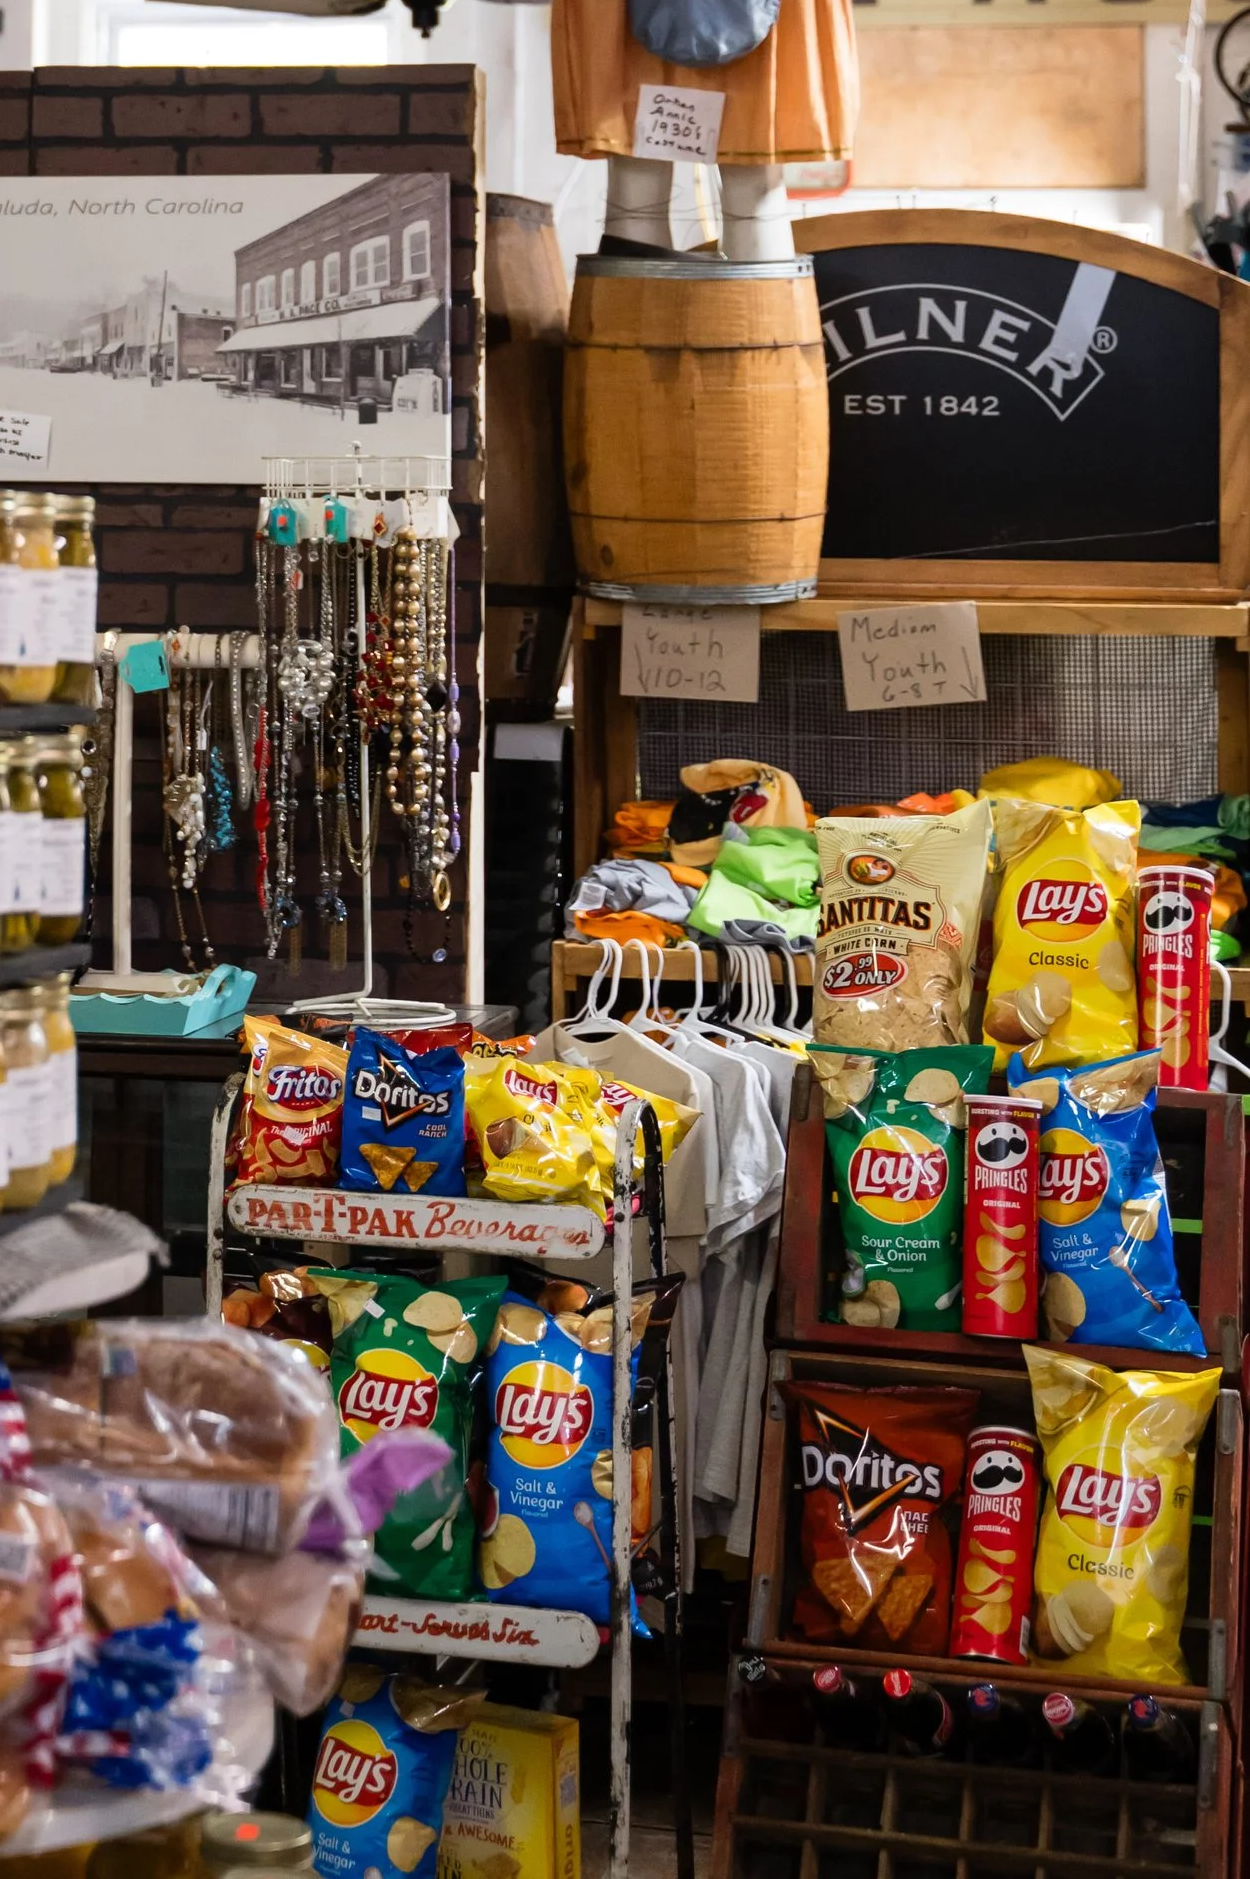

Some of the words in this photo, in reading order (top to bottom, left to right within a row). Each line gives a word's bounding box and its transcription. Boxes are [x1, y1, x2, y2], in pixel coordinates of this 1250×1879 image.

[67, 198, 136, 215] North
[144, 197, 244, 215] Carolina
[822, 296, 1085, 399] ILNER
[843, 394, 907, 415] EST
[923, 394, 1000, 416] 1842
[646, 627, 724, 659] Youth
[655, 667, 726, 692] 10-12
[861, 650, 947, 682] Youth
[1021, 880, 1105, 924] Lay's
[816, 895, 932, 938] SANTITAS
[833, 939, 861, 955] WHITE
[864, 938, 897, 950] CORN
[1142, 934, 1193, 959] PRINGLES
[1028, 951, 1089, 970] Classic
[854, 971, 898, 986] ONLY
[267, 1064, 343, 1102] Fritos
[354, 1069, 450, 1115] Doritos
[289, 1120, 333, 1138] RIGINAL
[425, 1123, 447, 1132] COOL
[855, 1149, 946, 1202] Lay's
[974, 1164, 1028, 1195] PRINGLES
[983, 1199, 1021, 1209] ORIGINAL
[861, 1234, 893, 1248] Sour
[895, 1236, 940, 1249] Cream
[1050, 1246, 1099, 1263] Vinegar
[1052, 1235, 1079, 1249] Salt
[1083, 1233, 1093, 1245] &
[875, 1248, 885, 1262] &
[887, 1249, 927, 1262] Onion
[345, 1372, 435, 1432] Lay's
[500, 1383, 588, 1446] Lay's
[802, 1445, 941, 1498] Doritos
[515, 1478, 542, 1494] Salt
[546, 1480, 556, 1495] &
[1061, 1465, 1157, 1528] Lay's
[509, 1491, 564, 1512] Vinegar
[968, 1494, 1021, 1522] PRINGLES
[973, 1524, 1012, 1536] ORIGINAL
[1067, 1553, 1135, 1581] Classic
[358, 1612, 490, 1642] art-Serves
[492, 1617, 540, 1647] Six
[458, 1736, 493, 1759] 00%
[315, 1738, 392, 1803] Lay's
[454, 1755, 509, 1787] HOLE
[451, 1777, 503, 1810] RAIN
[317, 1831, 339, 1851] Salt
[341, 1840, 351, 1855] &
[457, 1823, 516, 1851] AWESOME
[312, 1843, 356, 1870] Vinegar
